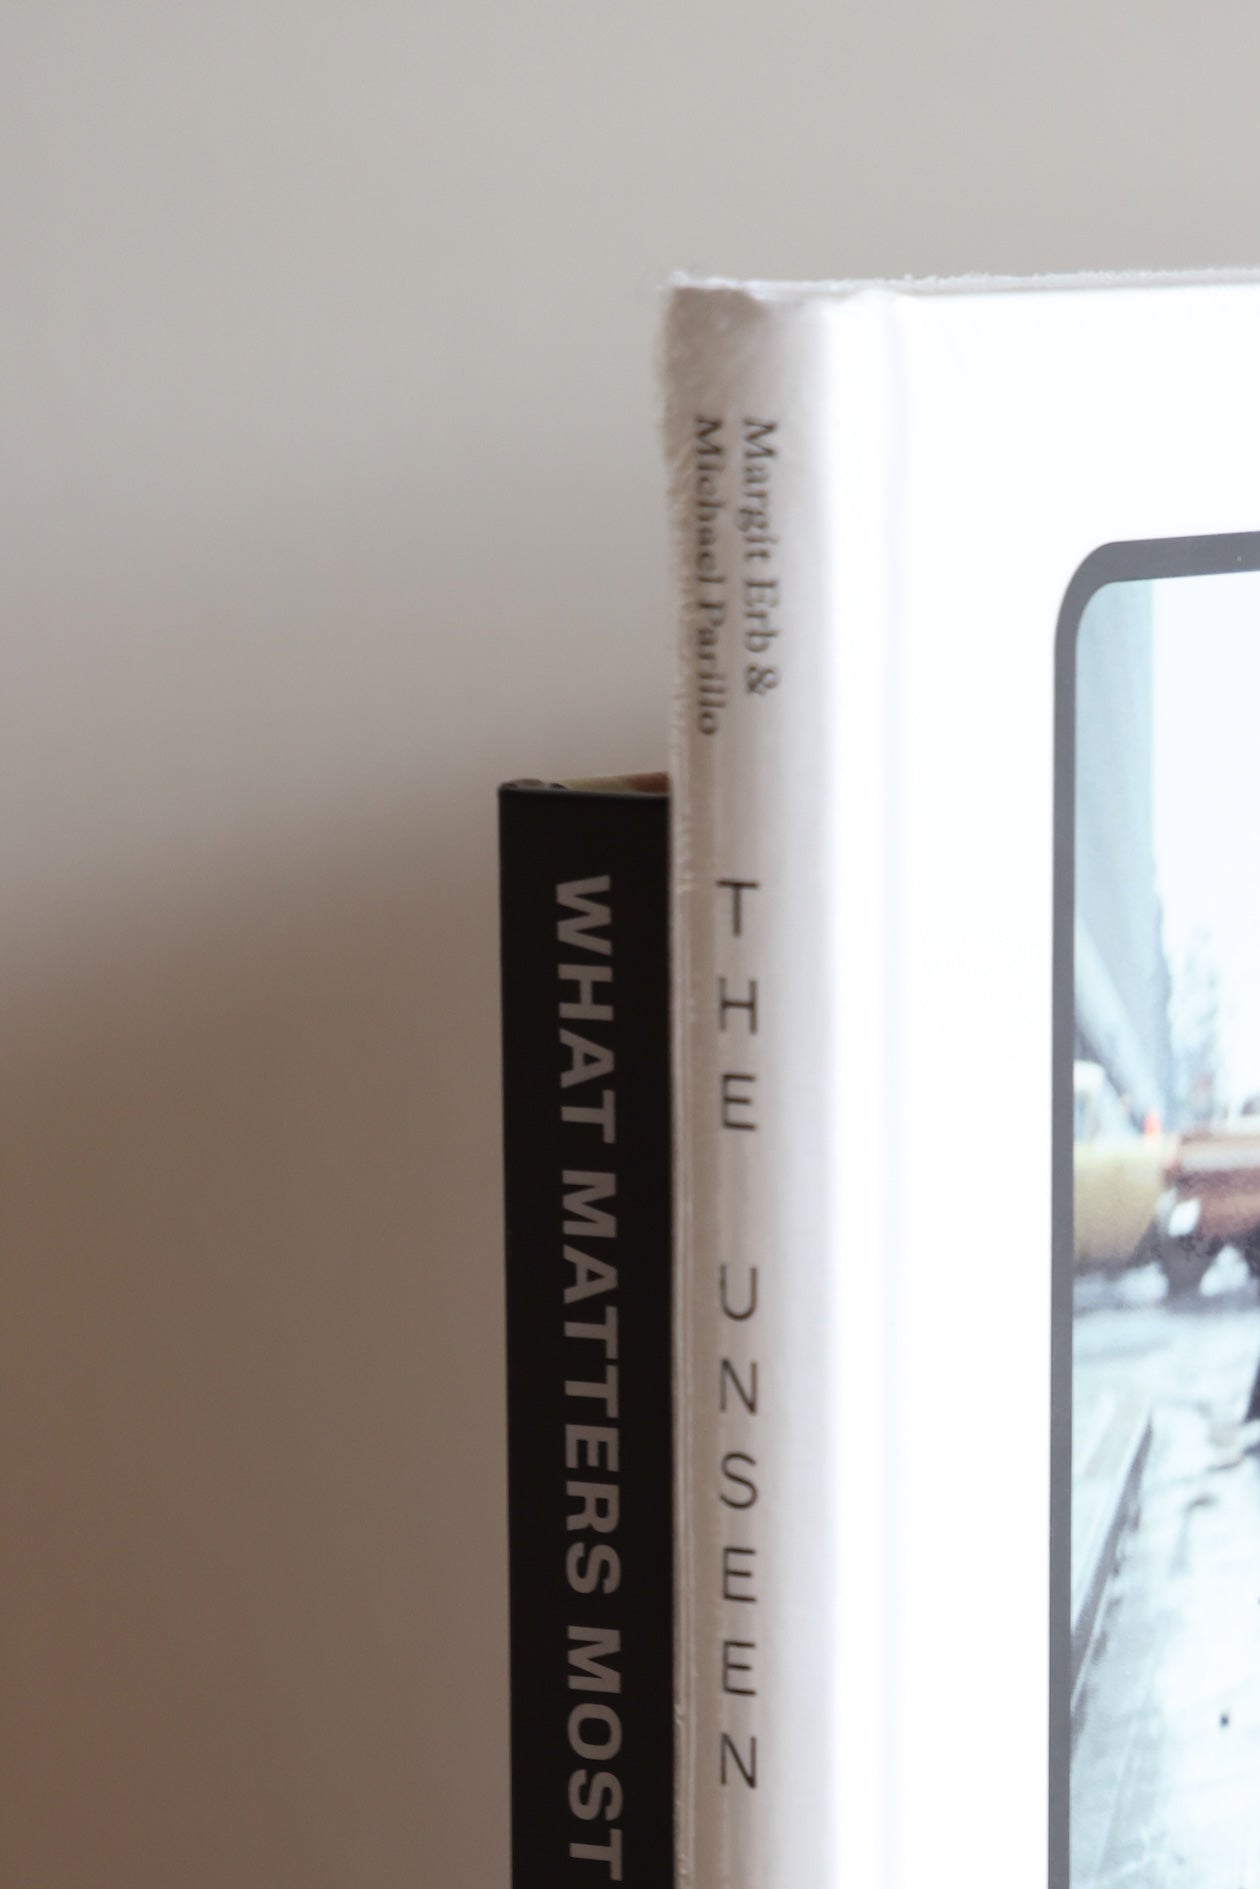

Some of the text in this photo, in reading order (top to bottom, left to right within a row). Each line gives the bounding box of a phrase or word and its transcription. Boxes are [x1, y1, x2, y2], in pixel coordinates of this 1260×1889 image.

[695, 416, 727, 736] Michael Parillo
[736, 416, 781, 696] Margit Erb &
[716, 879, 760, 1132] THE
[555, 875, 623, 1882] WHAT MATTERS MOST
[719, 1264, 759, 1790] UNSEEN
